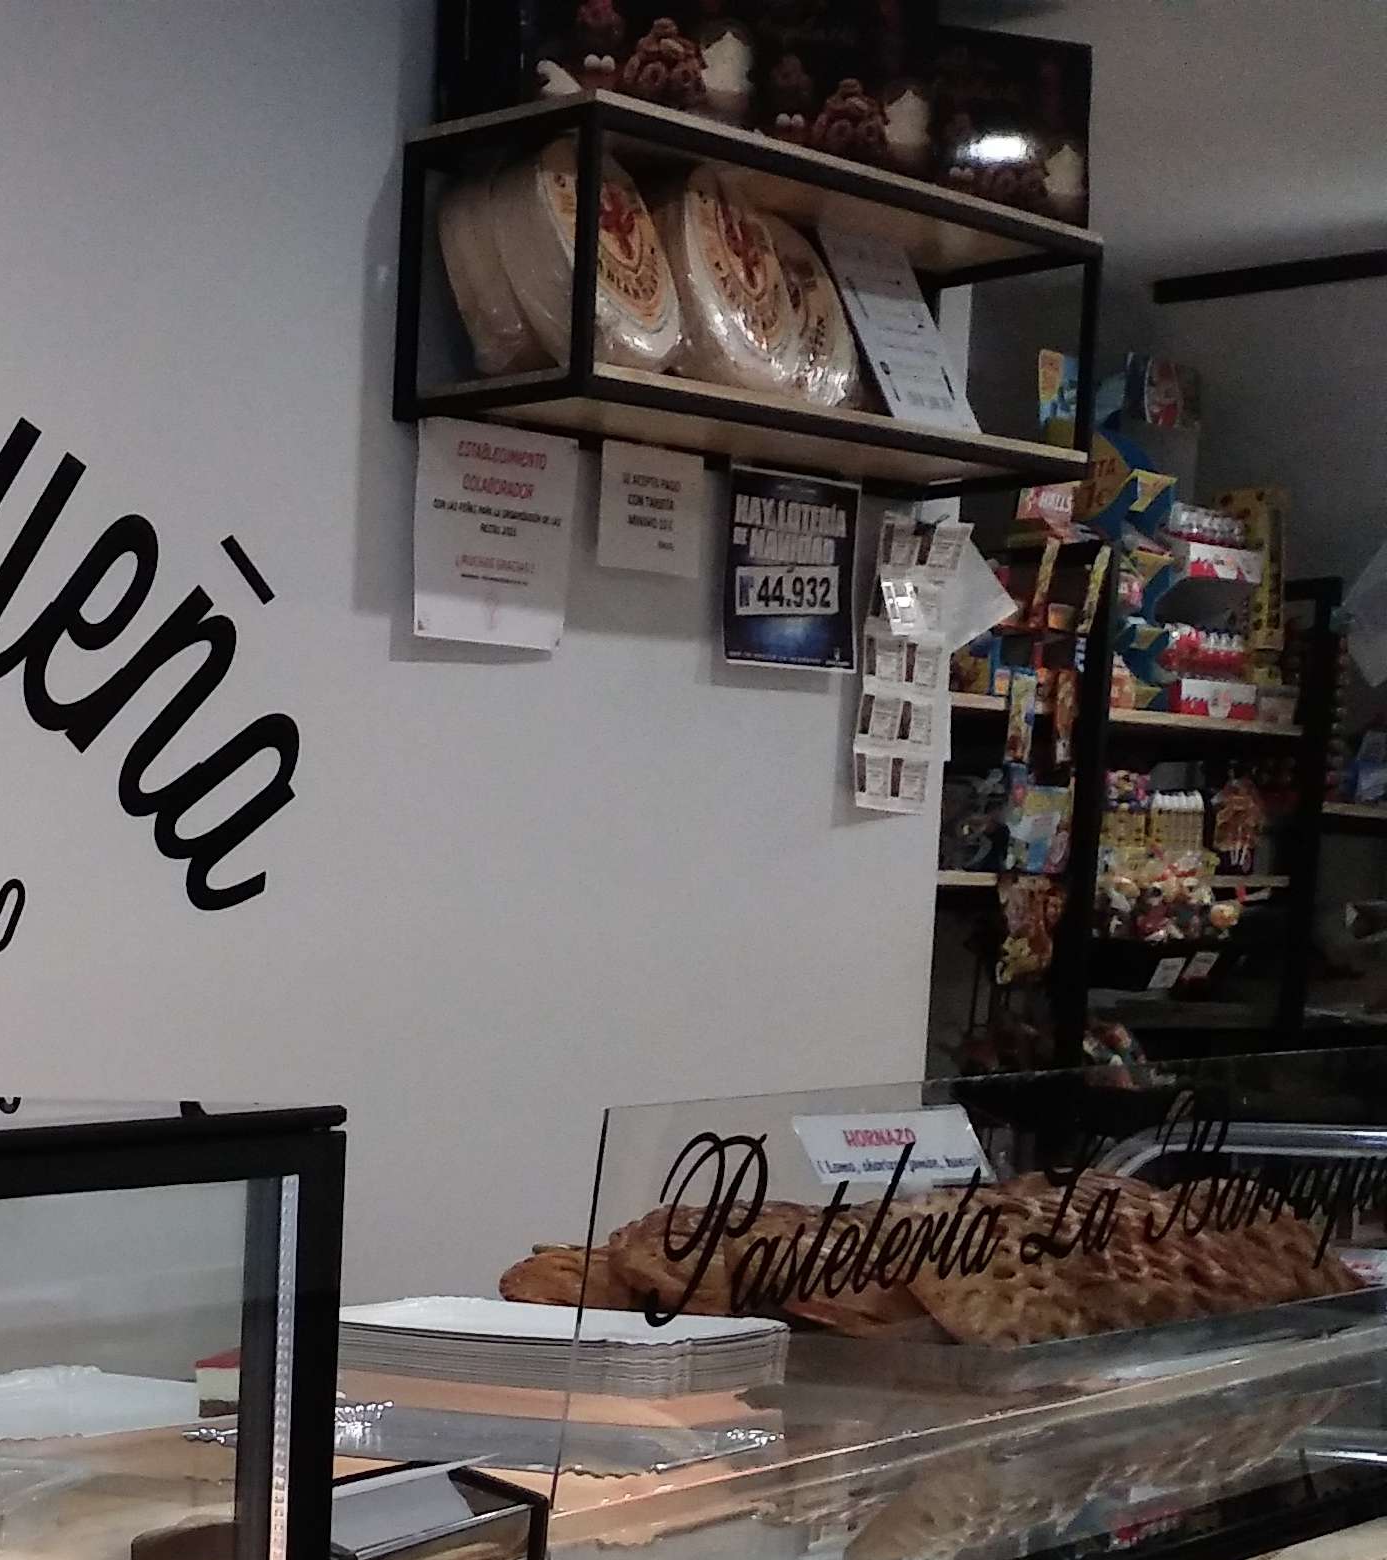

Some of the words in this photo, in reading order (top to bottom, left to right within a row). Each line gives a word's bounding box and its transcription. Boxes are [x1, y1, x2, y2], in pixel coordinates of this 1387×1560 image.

[457, 439, 548, 471] ESTABLECIMIENTO
[462, 472, 536, 500] COLABORADOR
[734, 493, 776, 529] HAY
[749, 528, 836, 565] NAVIDAD
[757, 575, 832, 609] 44.932
[842, 1127, 917, 1148] HORNAZO
[645, 1132, 1006, 1327] Pastelería
[1020, 1133, 1121, 1264] La
